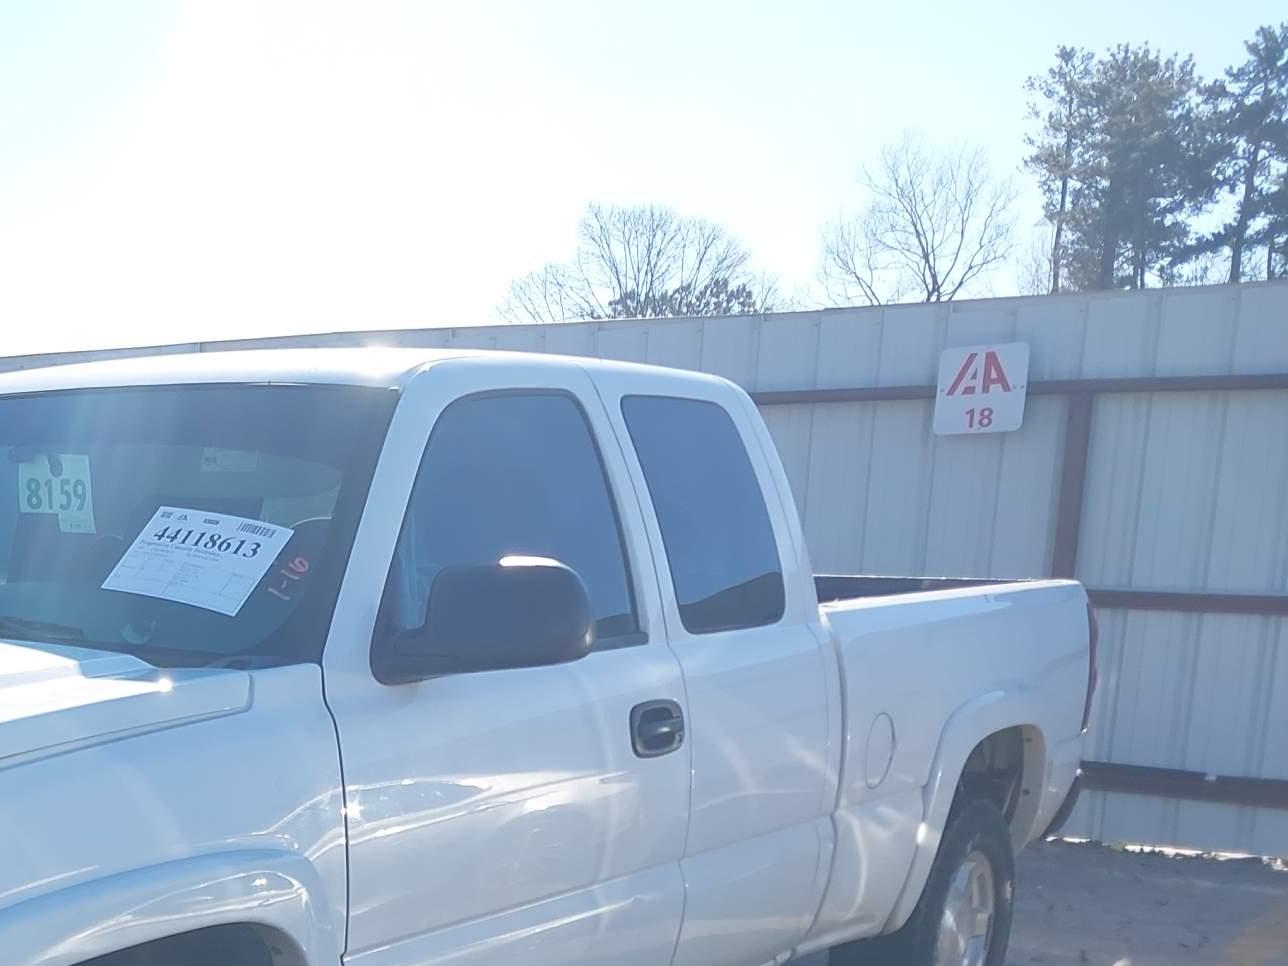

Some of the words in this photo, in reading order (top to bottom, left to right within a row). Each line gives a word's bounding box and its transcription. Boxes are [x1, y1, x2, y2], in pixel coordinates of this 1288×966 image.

[964, 407, 994, 429] 18
[25, 477, 87, 512] 8159
[153, 525, 261, 558] 44118613
